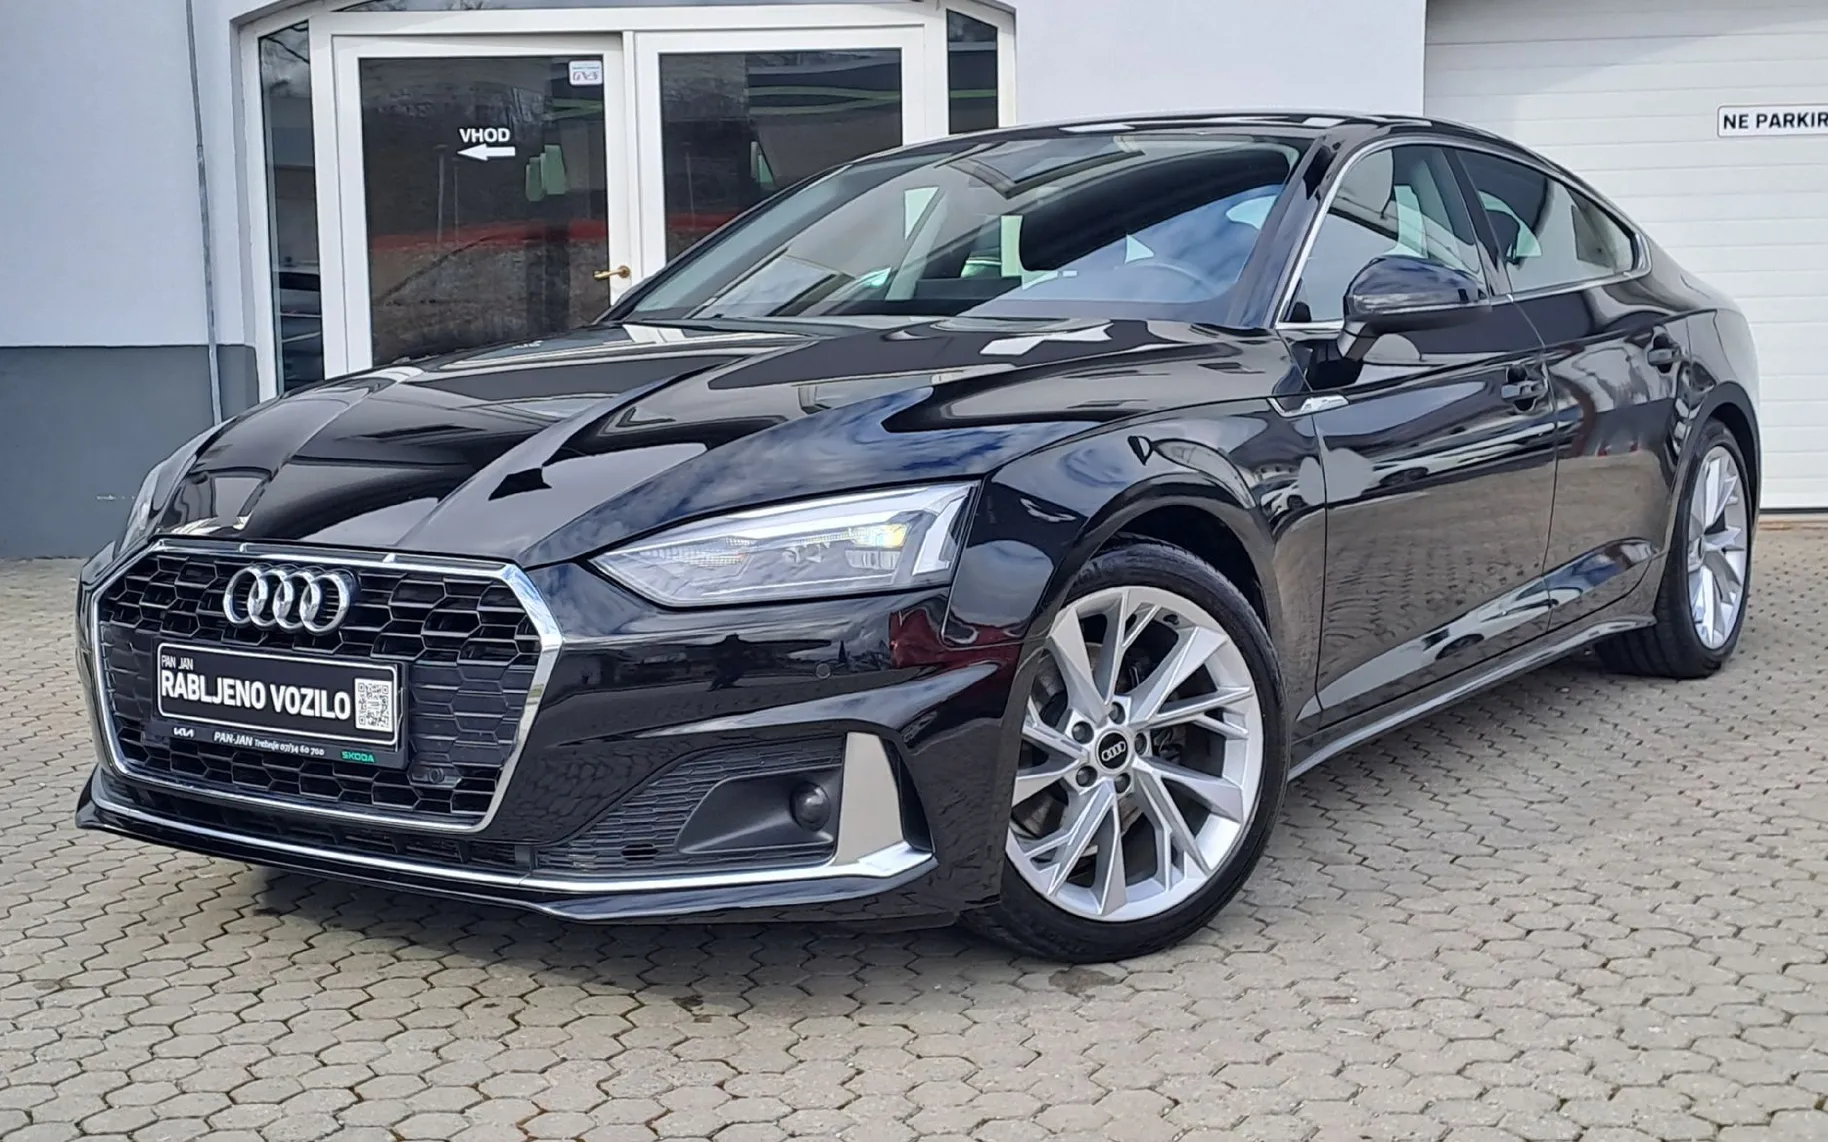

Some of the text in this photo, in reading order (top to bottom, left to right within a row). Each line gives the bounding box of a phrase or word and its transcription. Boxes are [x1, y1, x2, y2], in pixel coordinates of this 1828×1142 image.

[1723, 112, 1828, 129] NE PARKIR
[459, 128, 511, 143] VHOD
[161, 654, 194, 670] PAN JAN
[161, 670, 351, 720] RABLJENO VOZILO
[213, 732, 253, 746] PAN-JAN
